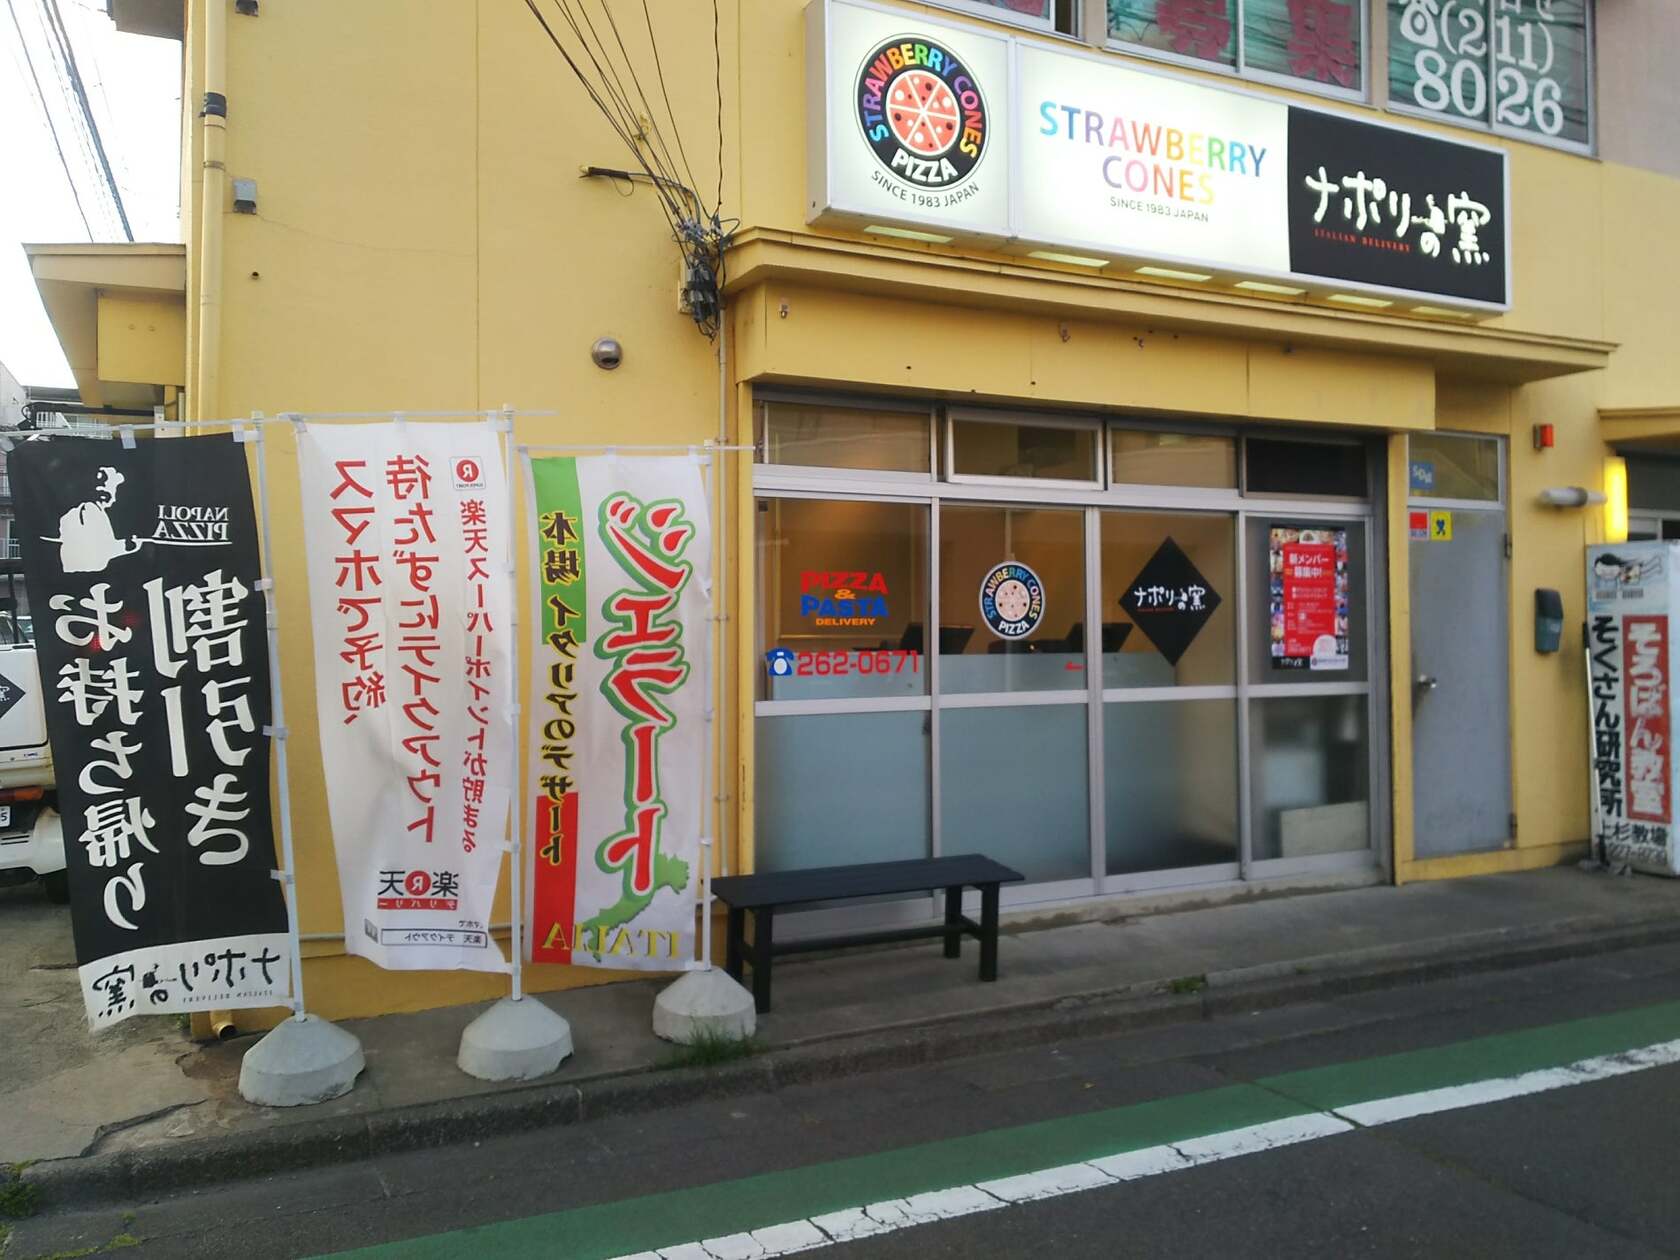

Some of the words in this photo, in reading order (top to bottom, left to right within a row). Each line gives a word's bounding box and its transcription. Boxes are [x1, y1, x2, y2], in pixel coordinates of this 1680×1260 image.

[863, 43, 958, 142] STRAWBERRY
[954, 75, 983, 158] CONES
[1414, 49, 1564, 136] 8026
[1039, 100, 1267, 177] STRAWBERRY
[891, 147, 958, 184] PIZZA
[871, 170, 907, 201] SINCE
[911, 193, 941, 208] 1983
[944, 181, 980, 207] JAPAN
[1102, 155, 1216, 206] CONES
[1109, 196, 1144, 212] SINCE
[1146, 203, 1172, 217] 1983
[1174, 207, 1209, 223] JAPAN
[1305, 166, 1491, 265] ナポリの窯
[1313, 228, 1357, 245] ITALIAN
[1361, 234, 1411, 253] DELIVERY
[801, 570, 890, 595] PIZZA
[834, 588, 857, 600] &
[983, 567, 1029, 619] STRAWBERRY
[1026, 578, 1043, 620] CONES
[800, 594, 890, 617] PASTA
[1133, 584, 1206, 611] ナポリの窯
[815, 617, 877, 627] DELIVERY
[998, 619, 1030, 635] PIZZA
[796, 648, 920, 677] 262-0671
